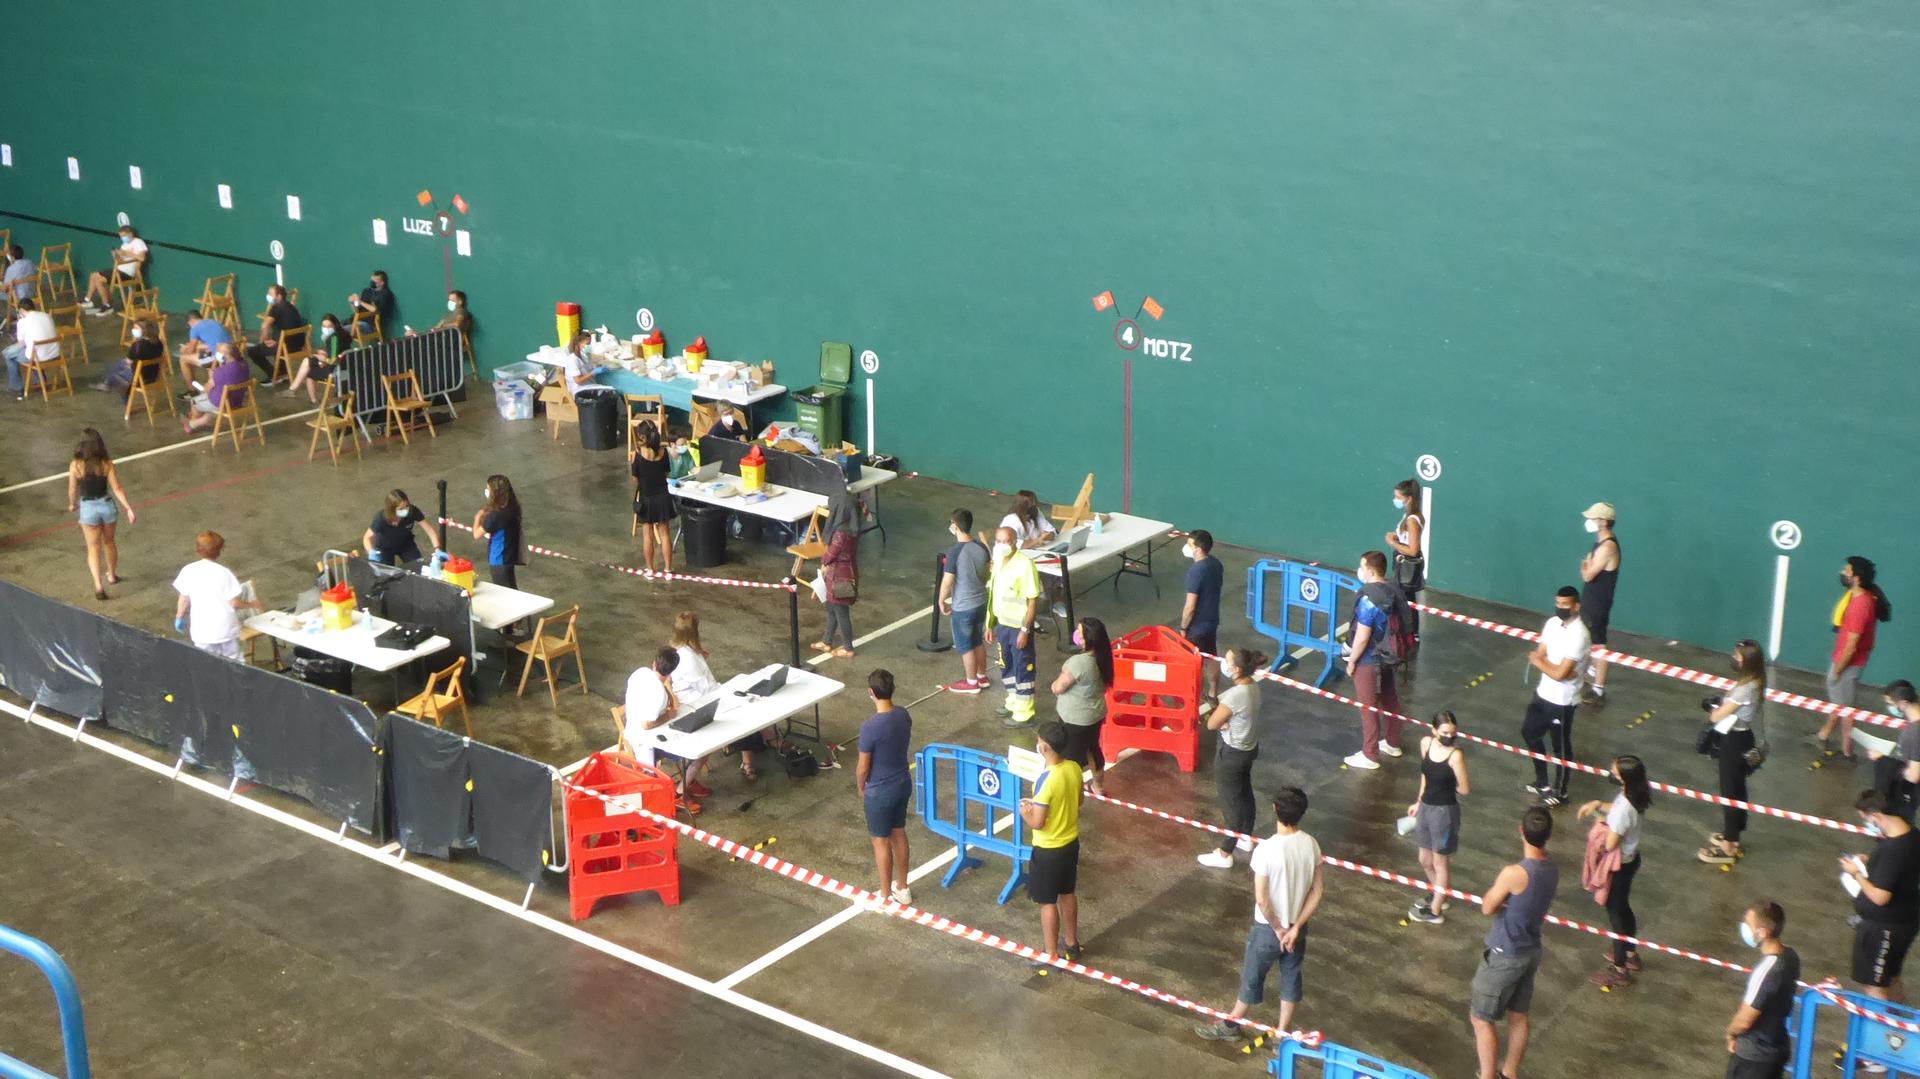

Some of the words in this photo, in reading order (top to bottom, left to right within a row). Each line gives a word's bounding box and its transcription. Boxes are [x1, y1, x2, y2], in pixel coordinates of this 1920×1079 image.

[403, 216, 434, 236] LUZE
[440, 216, 448, 231] 7
[640, 310, 650, 328] 6
[1122, 326, 1134, 345] 4
[1143, 336, 1193, 362] MOTZ
[865, 353, 875, 371] 5
[1423, 458, 1436, 477] 3
[1778, 525, 1794, 544] 2
